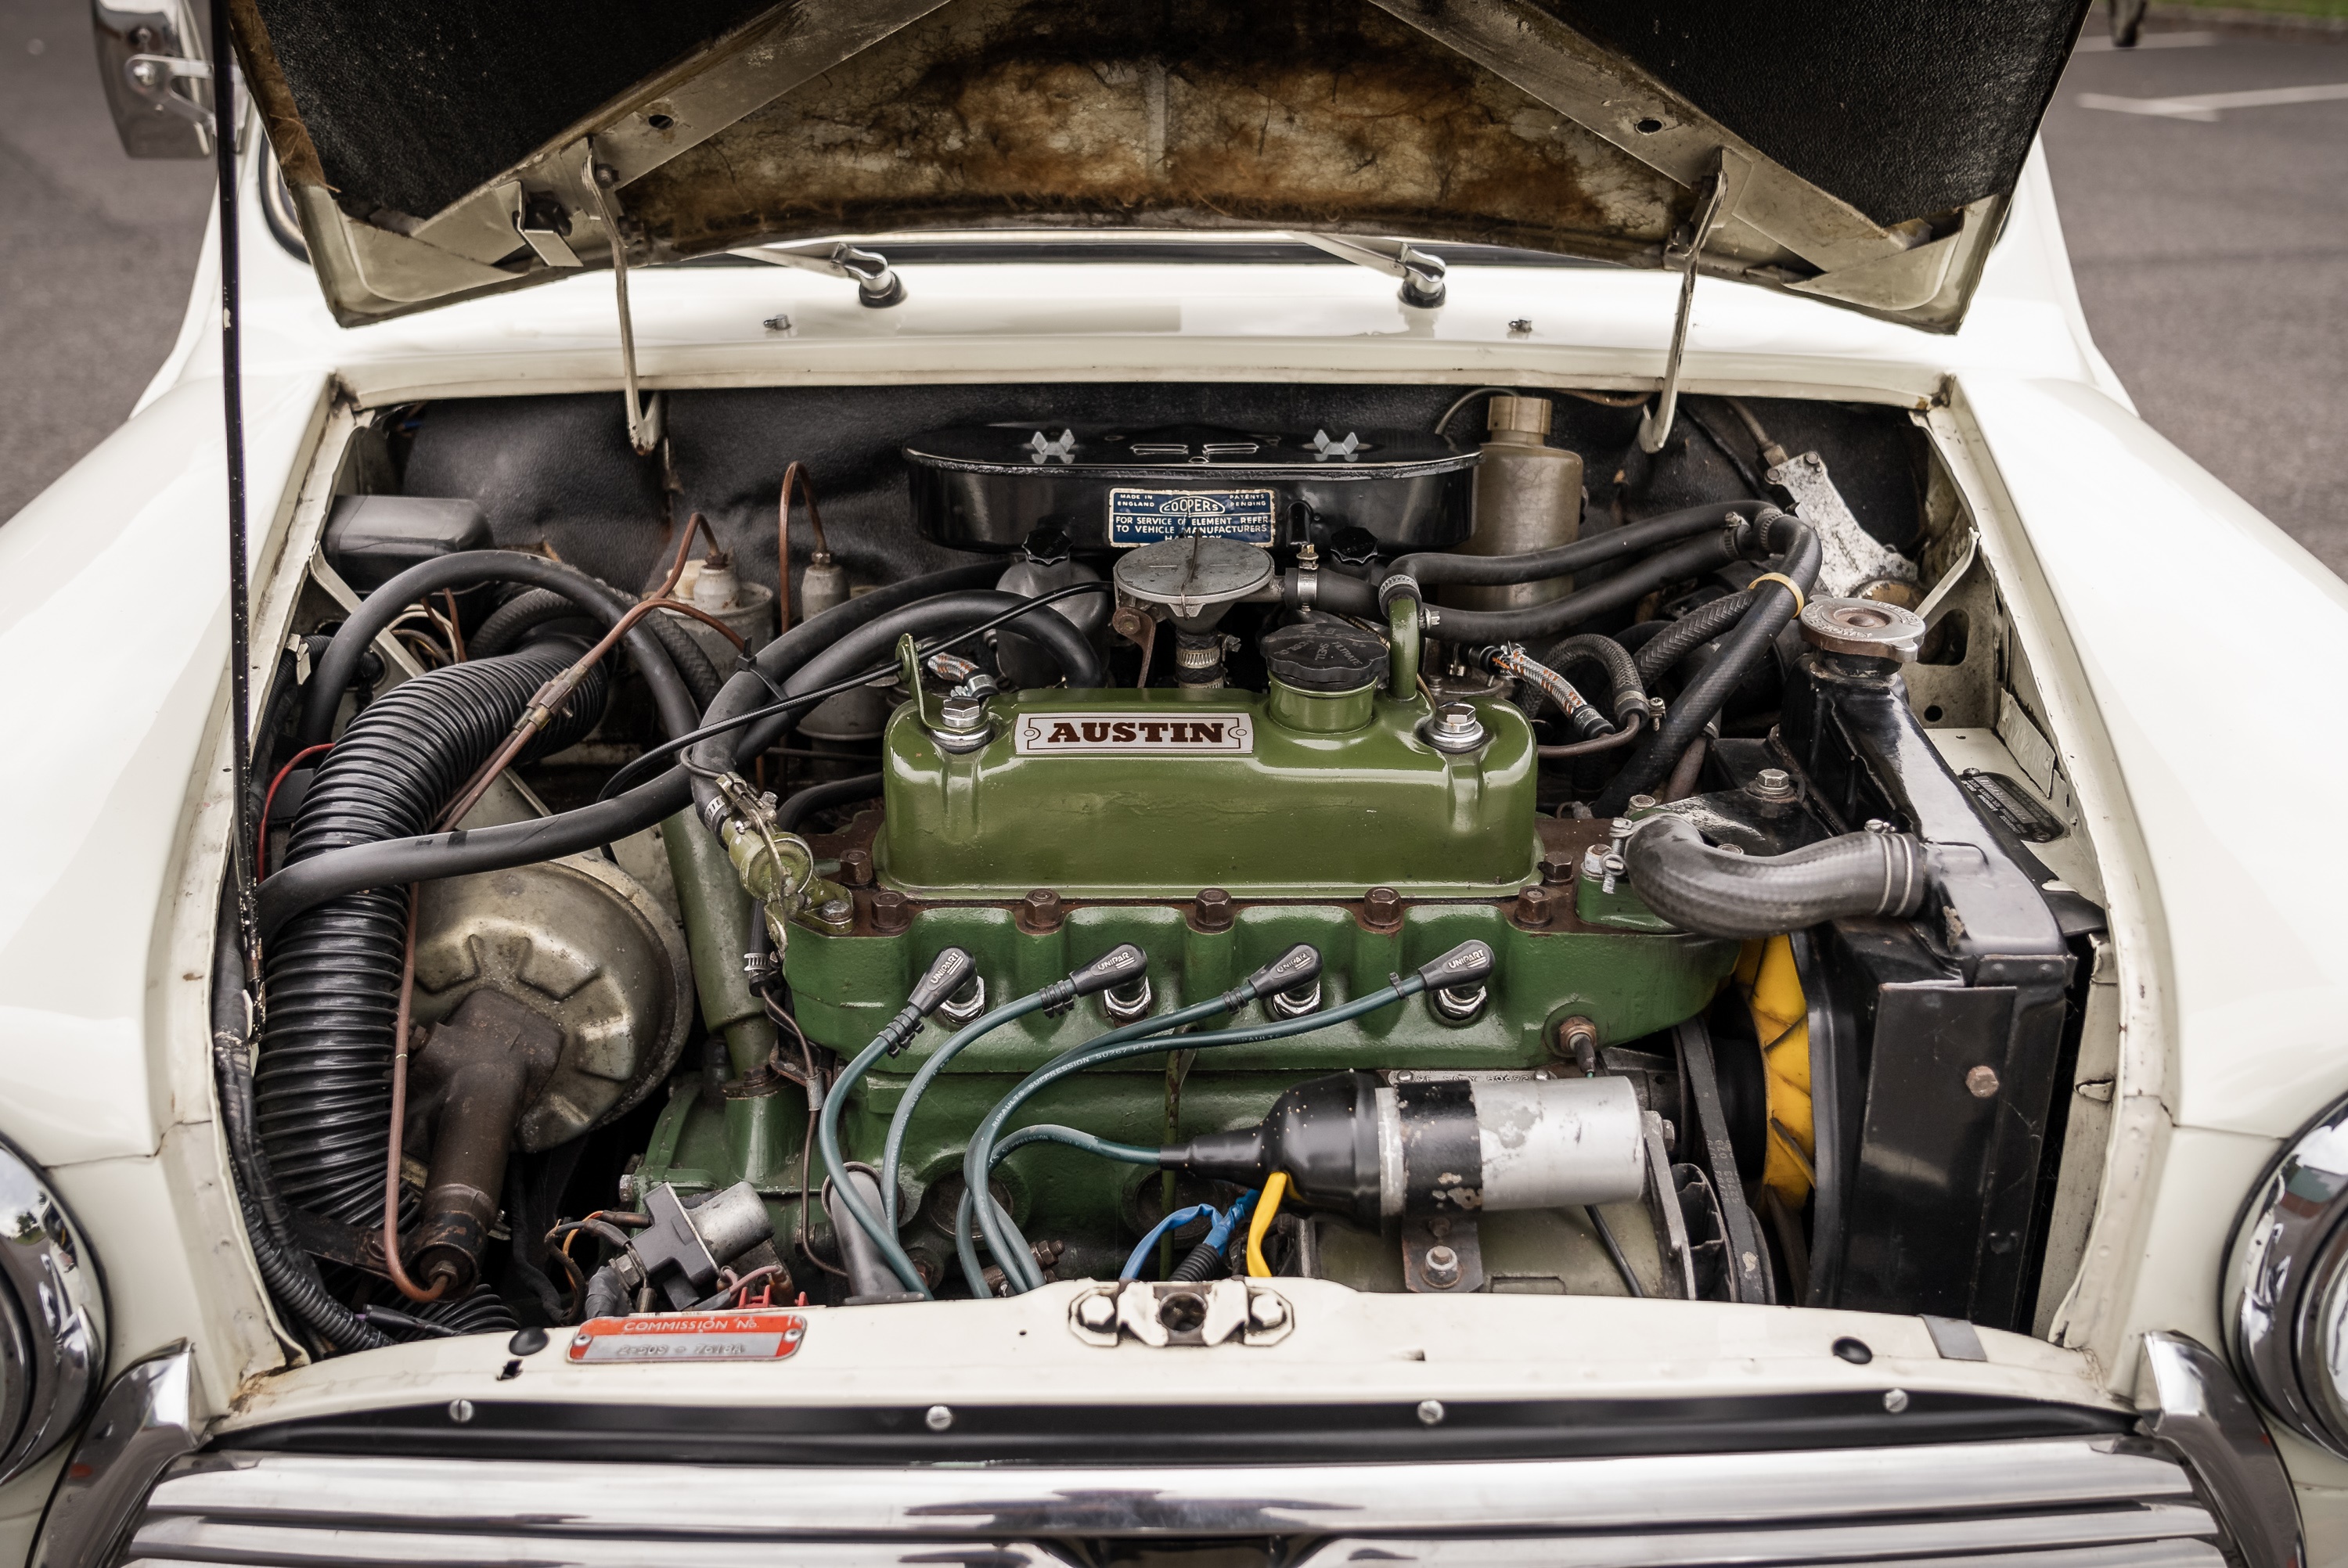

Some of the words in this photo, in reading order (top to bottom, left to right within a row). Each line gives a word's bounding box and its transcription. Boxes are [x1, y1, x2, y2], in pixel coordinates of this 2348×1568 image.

[1135, 525, 1175, 534] VEHICLE
[1183, 524, 1267, 534] MANUFACTURERS
[1191, 517, 1232, 526] ELEMENT
[1240, 516, 1269, 524] REFER
[1047, 722, 1224, 743] AUSTIN
[929, 952, 960, 985] UNIPART
[1447, 949, 1485, 969] UNIPART
[991, 1090, 1026, 1128] RIPAULTS
[1027, 1056, 1090, 1091] SUPPRESSION
[623, 1319, 729, 1332] COMMISSION
